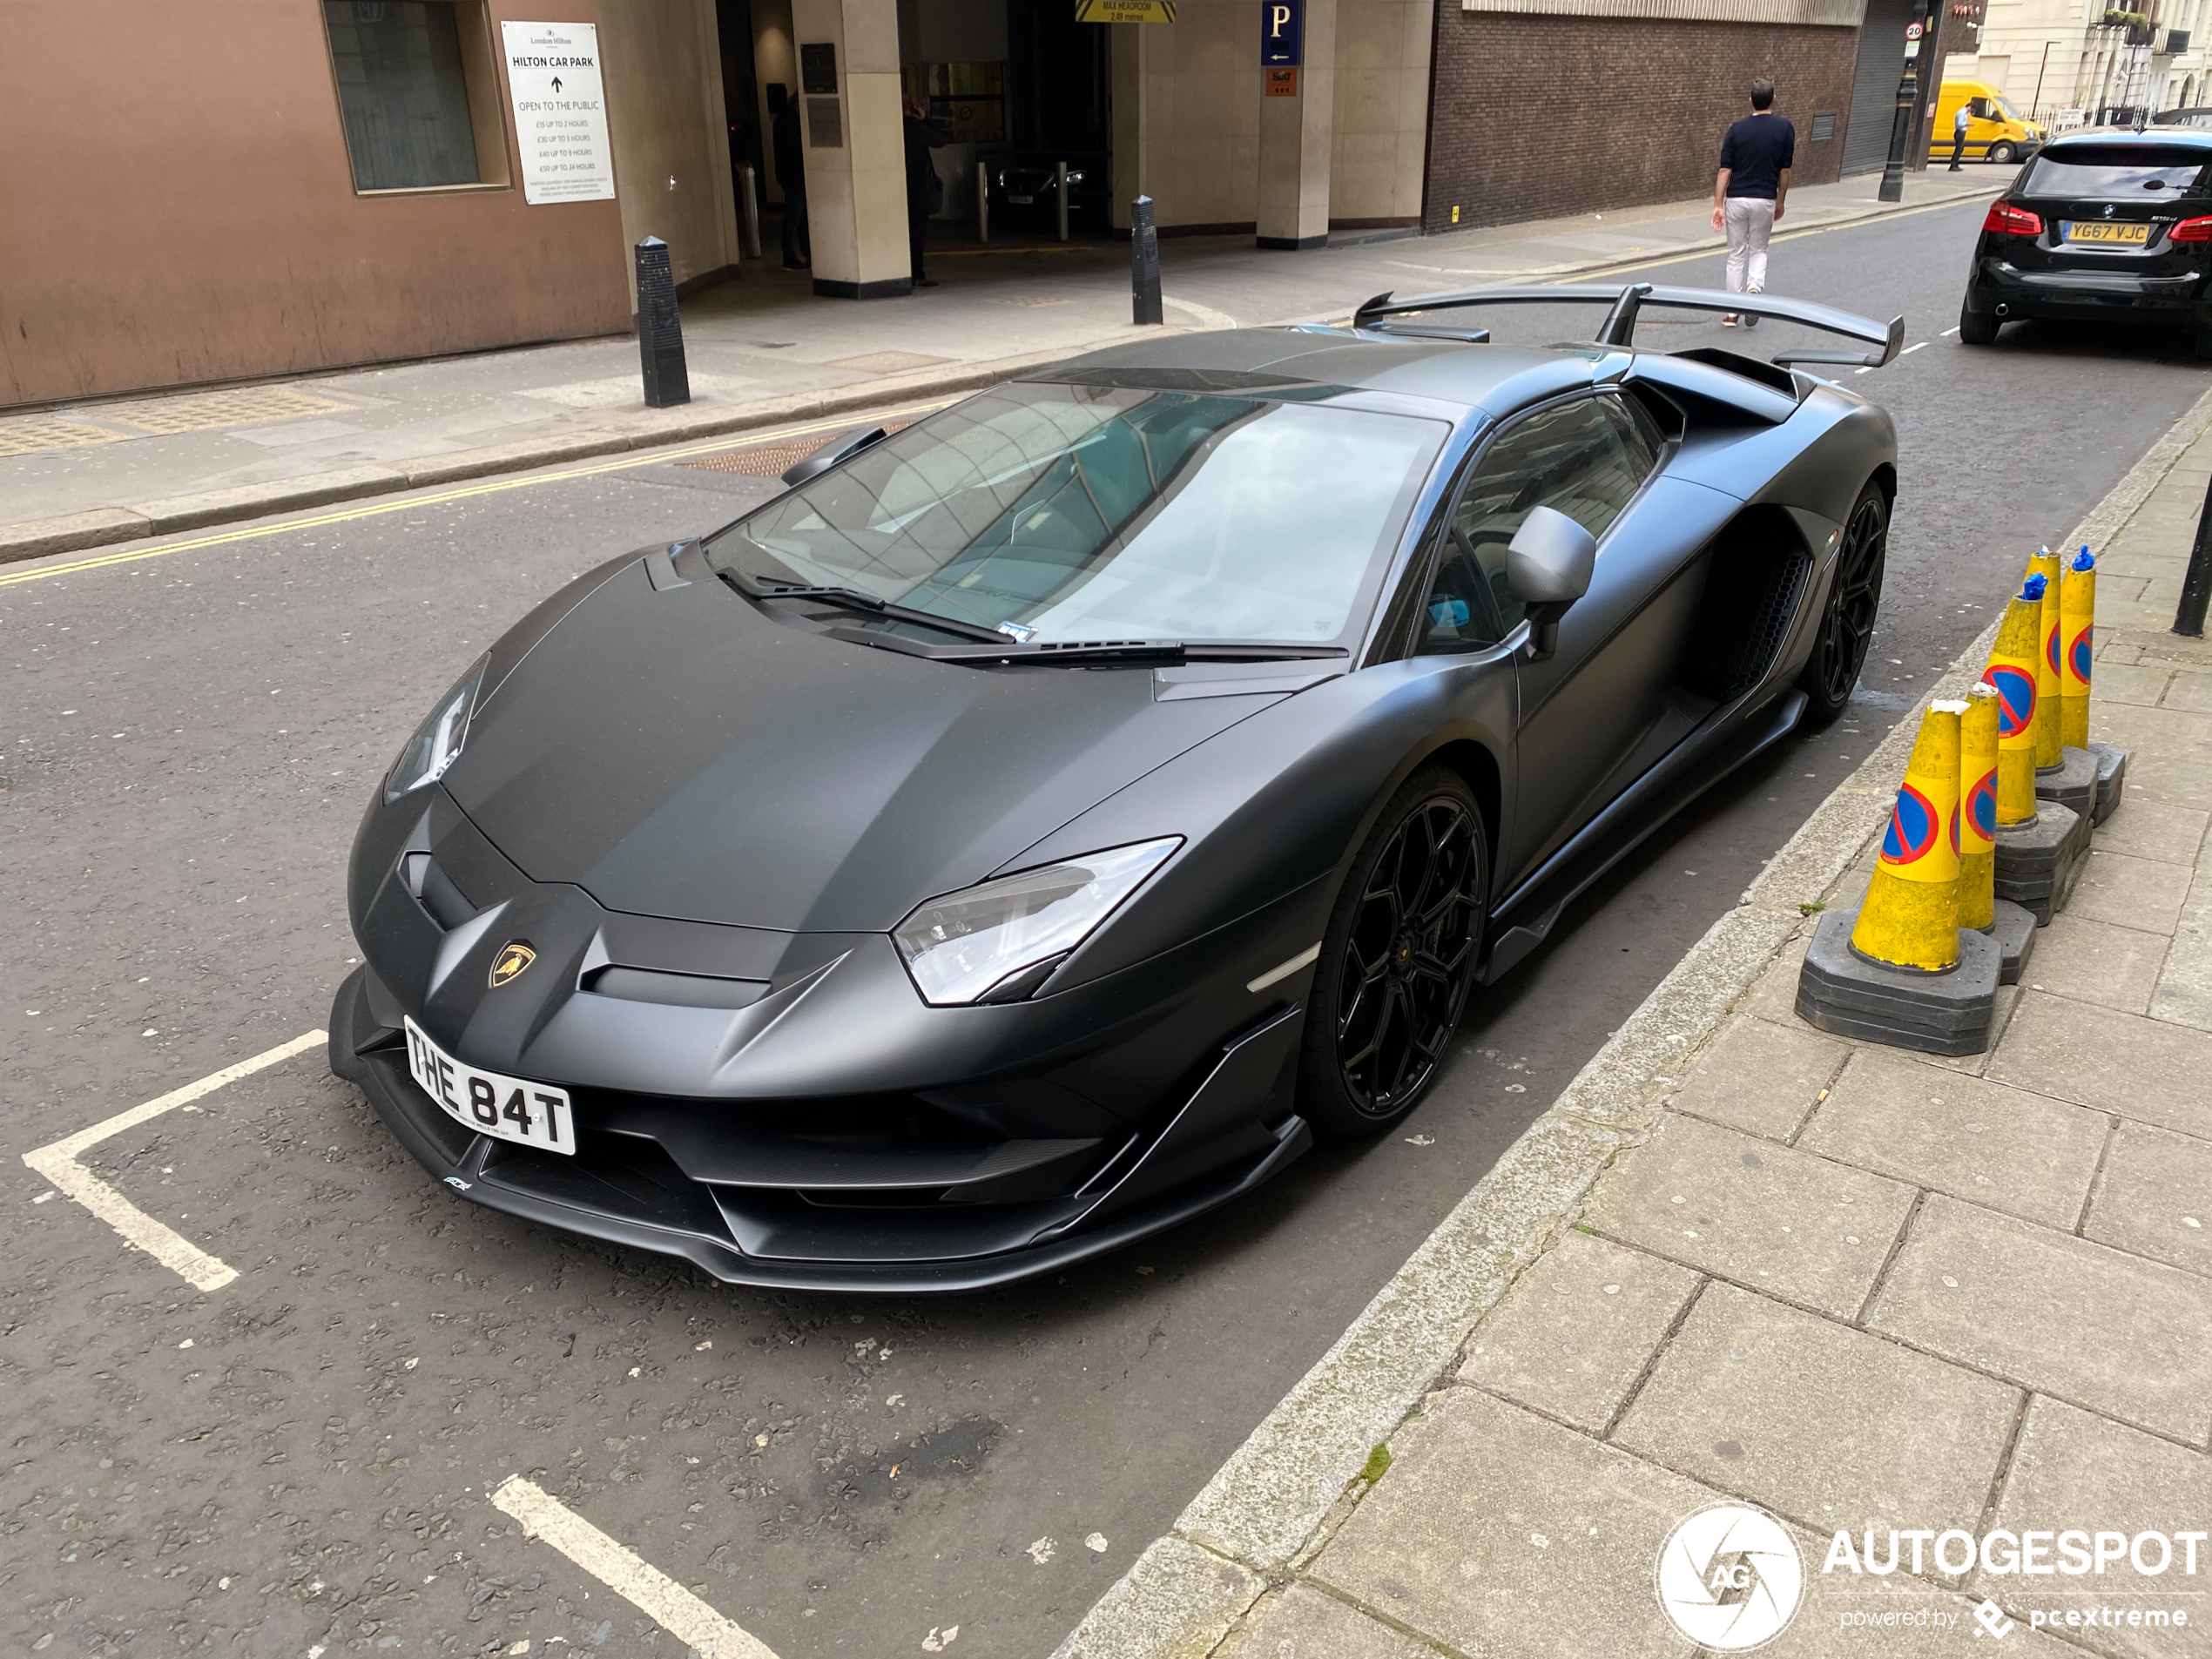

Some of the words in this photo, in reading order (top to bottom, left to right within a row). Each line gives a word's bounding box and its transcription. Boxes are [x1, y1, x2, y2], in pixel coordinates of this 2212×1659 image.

[1103, 1, 1116, 10] MAX
[1118, 2, 1151, 10] HEADROOM
[1110, 12, 1123, 21] 2.49
[1125, 12, 1143, 22] metres
[1271, 5, 1291, 37] P
[1908, 27, 1921, 36] 20
[513, 57, 548, 67] HILTON
[549, 57, 569, 67] CAR
[570, 57, 594, 67] PARK
[518, 101, 542, 111] OPEN
[543, 102, 554, 111] TO
[555, 101, 572, 111] THE
[572, 100, 599, 110] PUBLIC
[2074, 224, 2113, 239] YG67
[2116, 225, 2146, 239] VJC
[408, 1026, 460, 1113] THE
[468, 1076, 564, 1143] 84T
